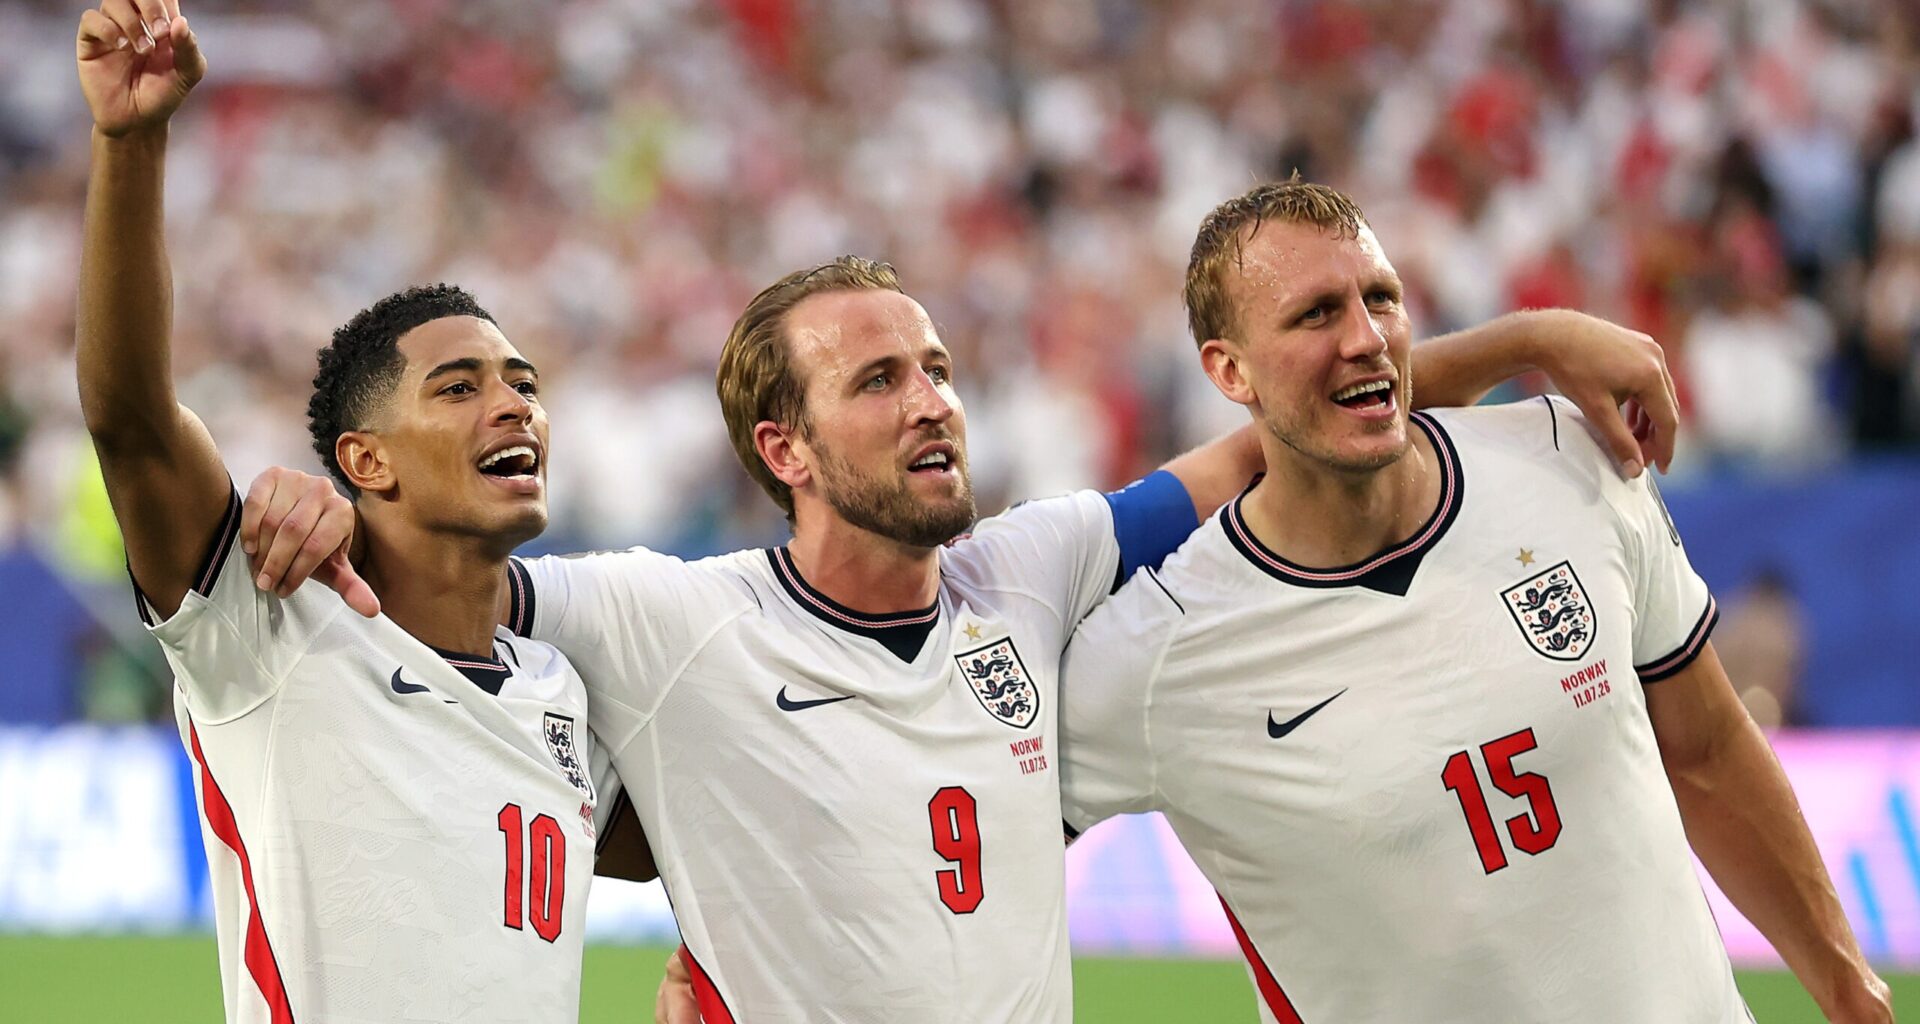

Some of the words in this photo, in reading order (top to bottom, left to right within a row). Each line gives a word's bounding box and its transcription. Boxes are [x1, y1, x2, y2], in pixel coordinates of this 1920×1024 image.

[1560, 659, 1607, 693] NORWAY
[1573, 680, 1611, 708] 11.07.26
[928, 786, 984, 914] 9
[1441, 727, 1562, 875] 15
[498, 802, 566, 944] 10
